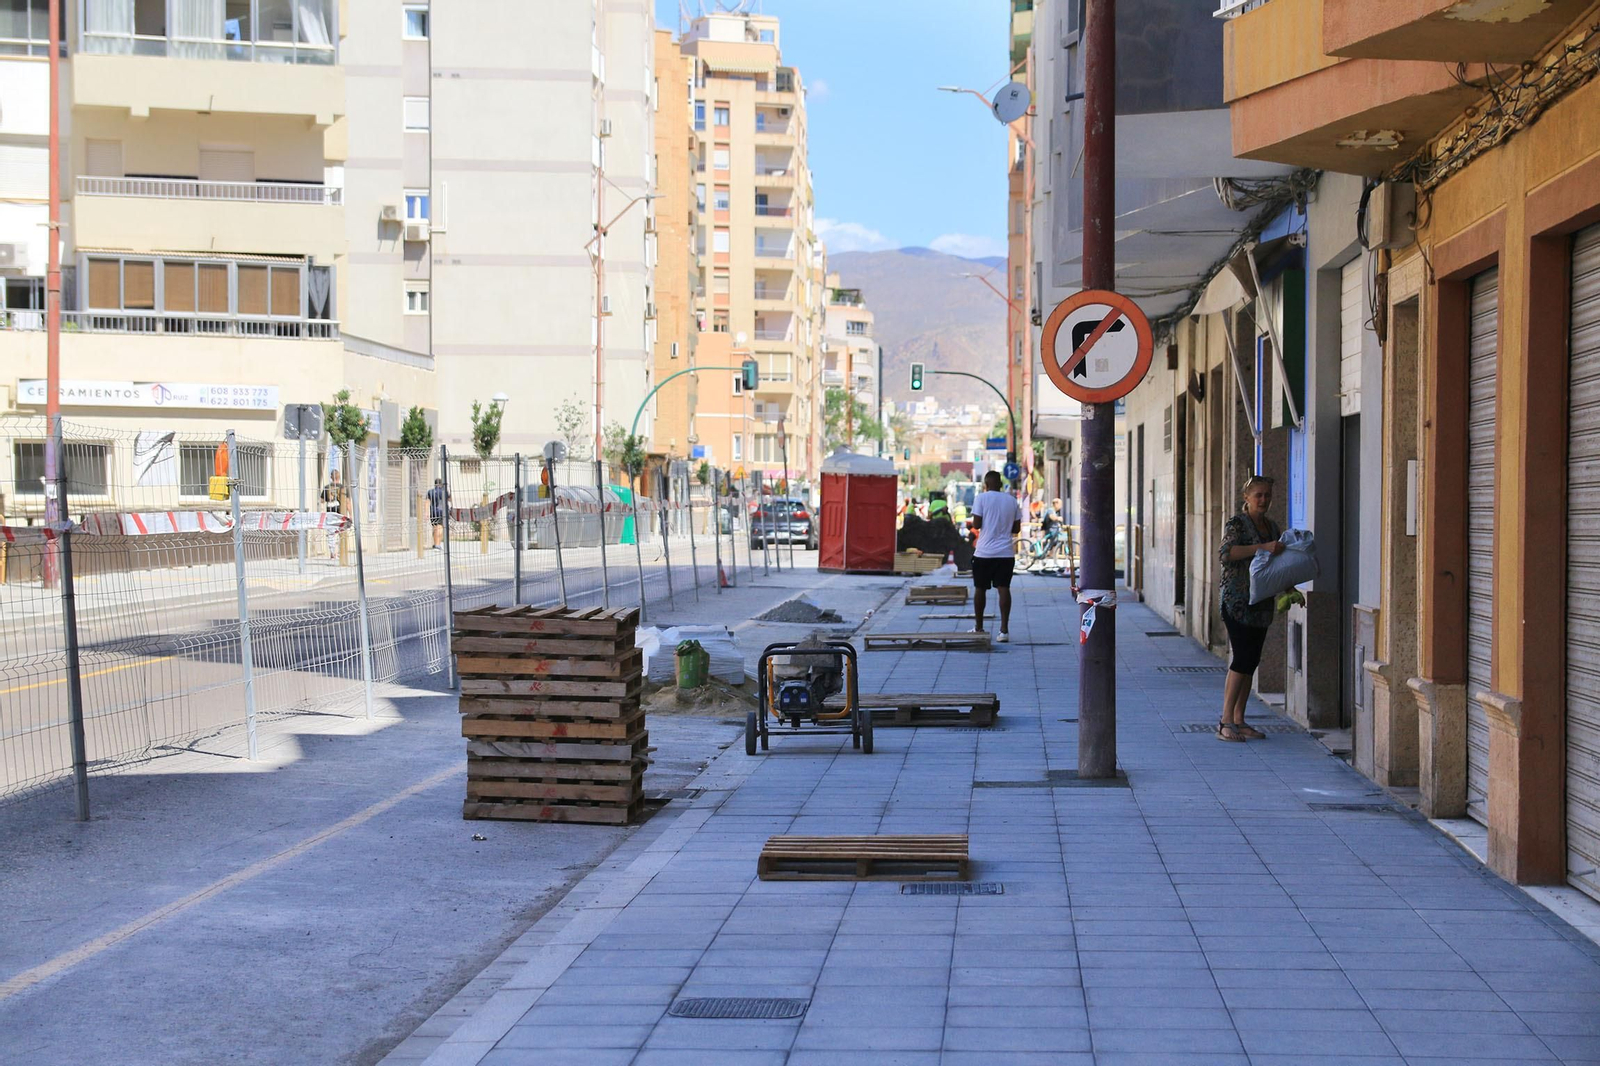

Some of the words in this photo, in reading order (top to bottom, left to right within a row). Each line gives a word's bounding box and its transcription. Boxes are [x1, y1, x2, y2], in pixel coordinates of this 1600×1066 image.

[27, 386, 140, 399] CERAMIENTOS
[210, 387, 229, 395] 608
[232, 387, 250, 396] 933
[252, 388, 269, 397] 773
[210, 397, 229, 406] 622
[232, 398, 250, 406] 801
[252, 398, 268, 407] 175
